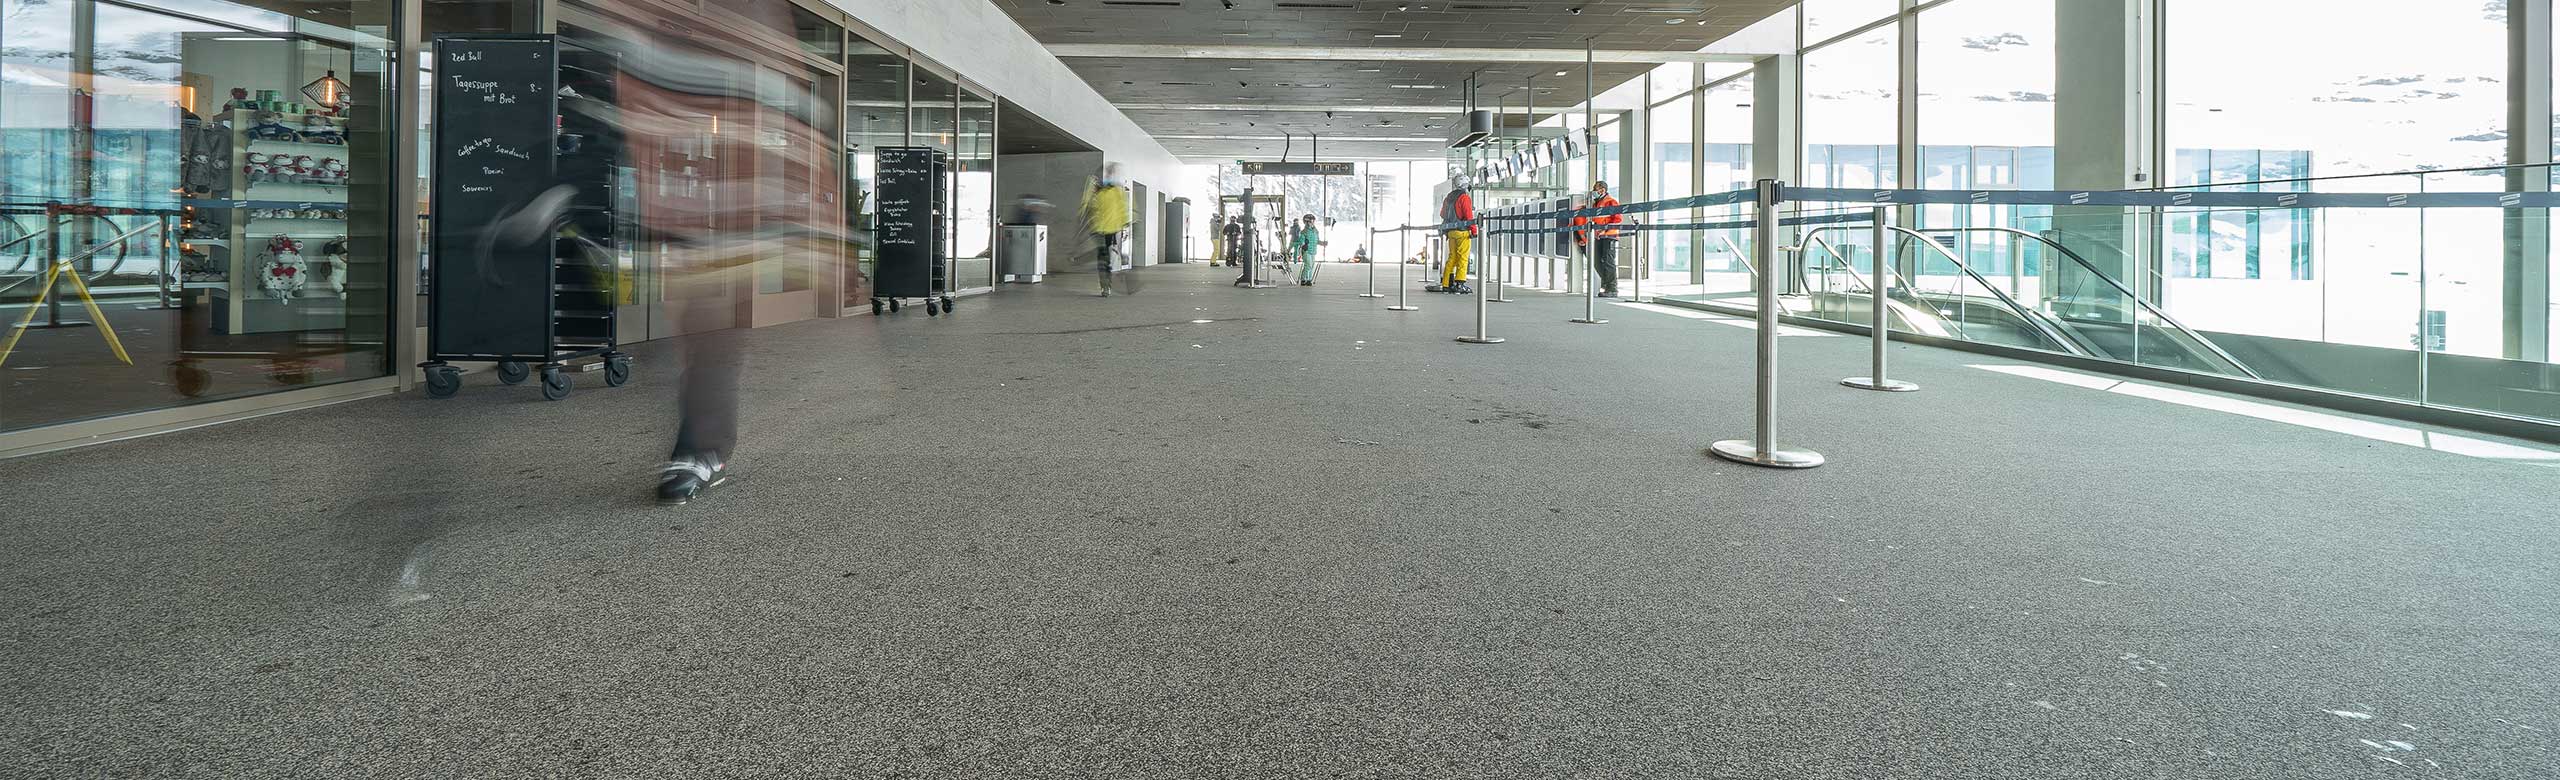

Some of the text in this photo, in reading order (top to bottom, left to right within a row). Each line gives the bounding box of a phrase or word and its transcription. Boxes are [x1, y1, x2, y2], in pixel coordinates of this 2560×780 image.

[468, 51, 482, 61] Bull
[452, 75, 498, 92] Tagessuppe
[484, 92, 516, 104] mit Brot
[495, 144, 530, 160] Sandwich
